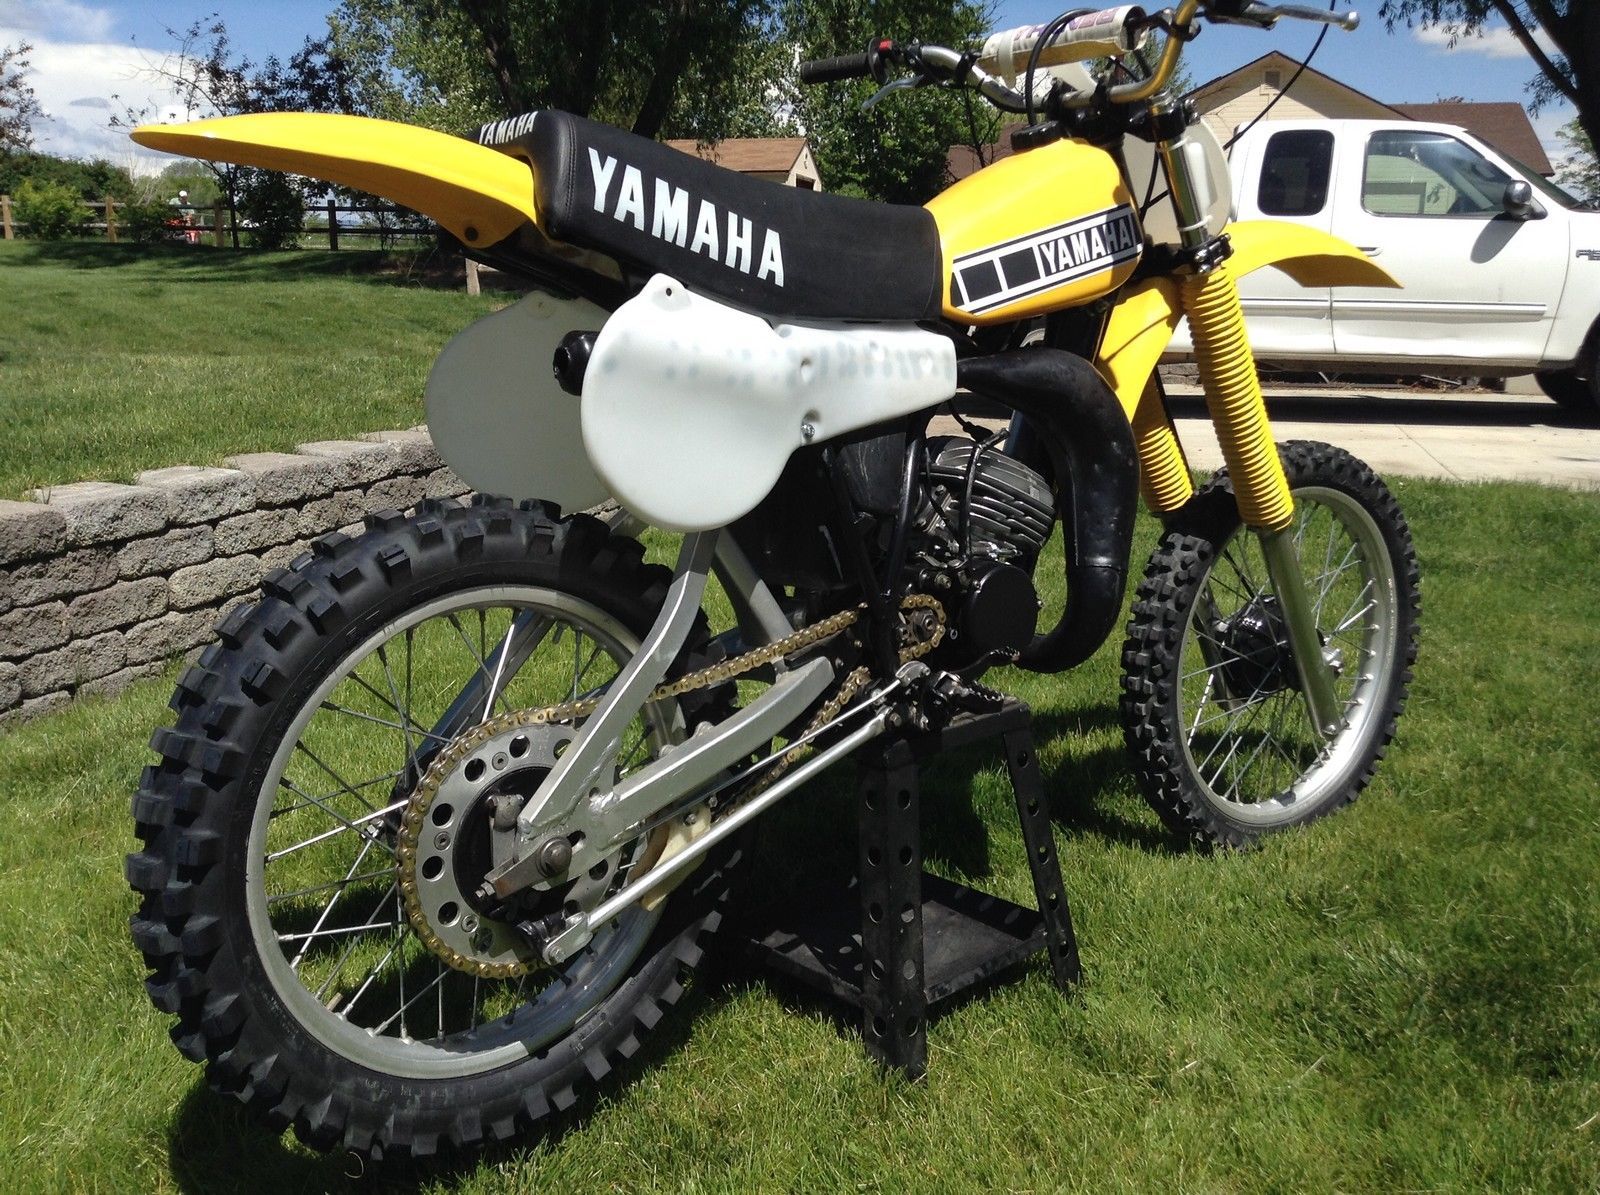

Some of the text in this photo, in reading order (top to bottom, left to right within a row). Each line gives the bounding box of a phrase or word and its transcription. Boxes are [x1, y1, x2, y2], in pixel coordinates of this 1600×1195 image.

[479, 111, 539, 145] YAMAHA
[588, 147, 784, 288] YAMAHA
[1039, 216, 1133, 274] YAMAHA
